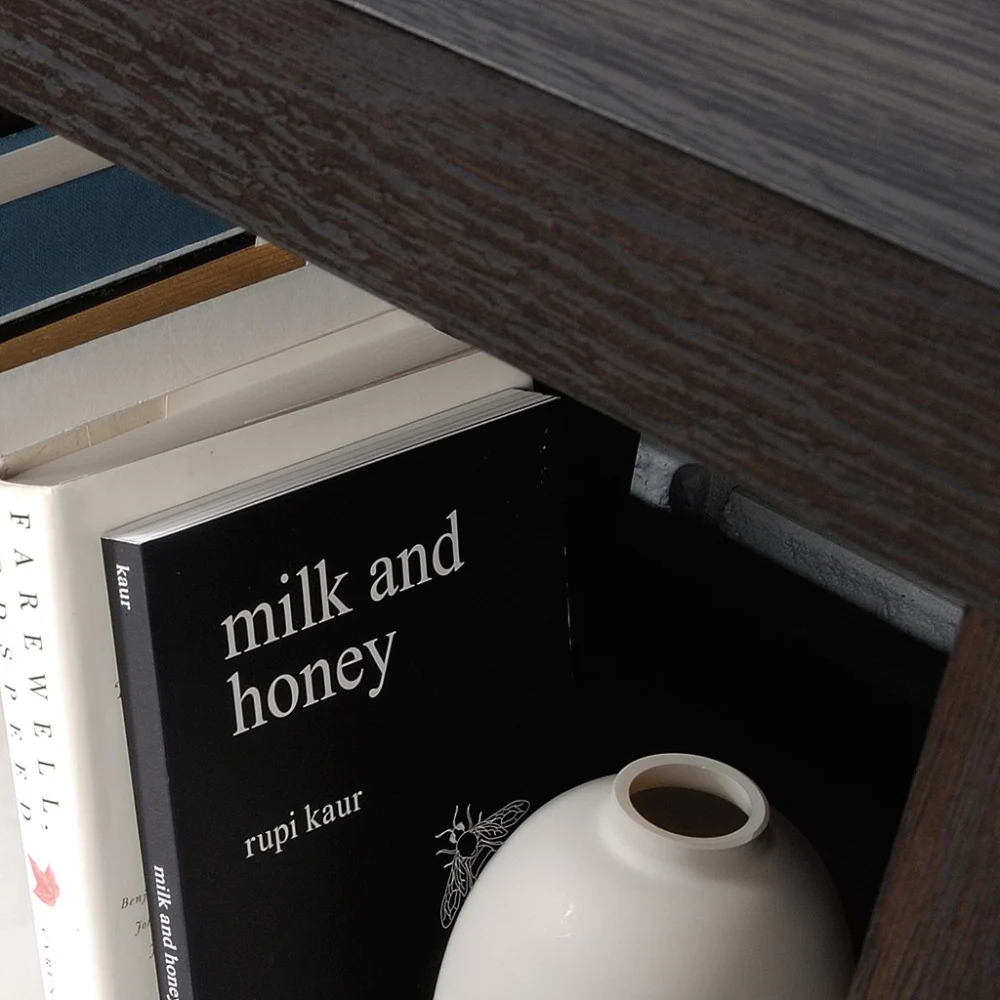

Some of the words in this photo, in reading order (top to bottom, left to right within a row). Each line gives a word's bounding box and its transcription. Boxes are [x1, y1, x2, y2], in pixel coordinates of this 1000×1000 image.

[115, 563, 131, 611] kaur
[219, 558, 354, 661] milk
[369, 509, 466, 602] and
[9, 510, 60, 831] FAREWELL,
[226, 631, 397, 737] honey
[243, 810, 299, 860] rupi
[303, 790, 364, 833] kaur
[153, 865, 172, 911] milk
[159, 912, 178, 951] and
